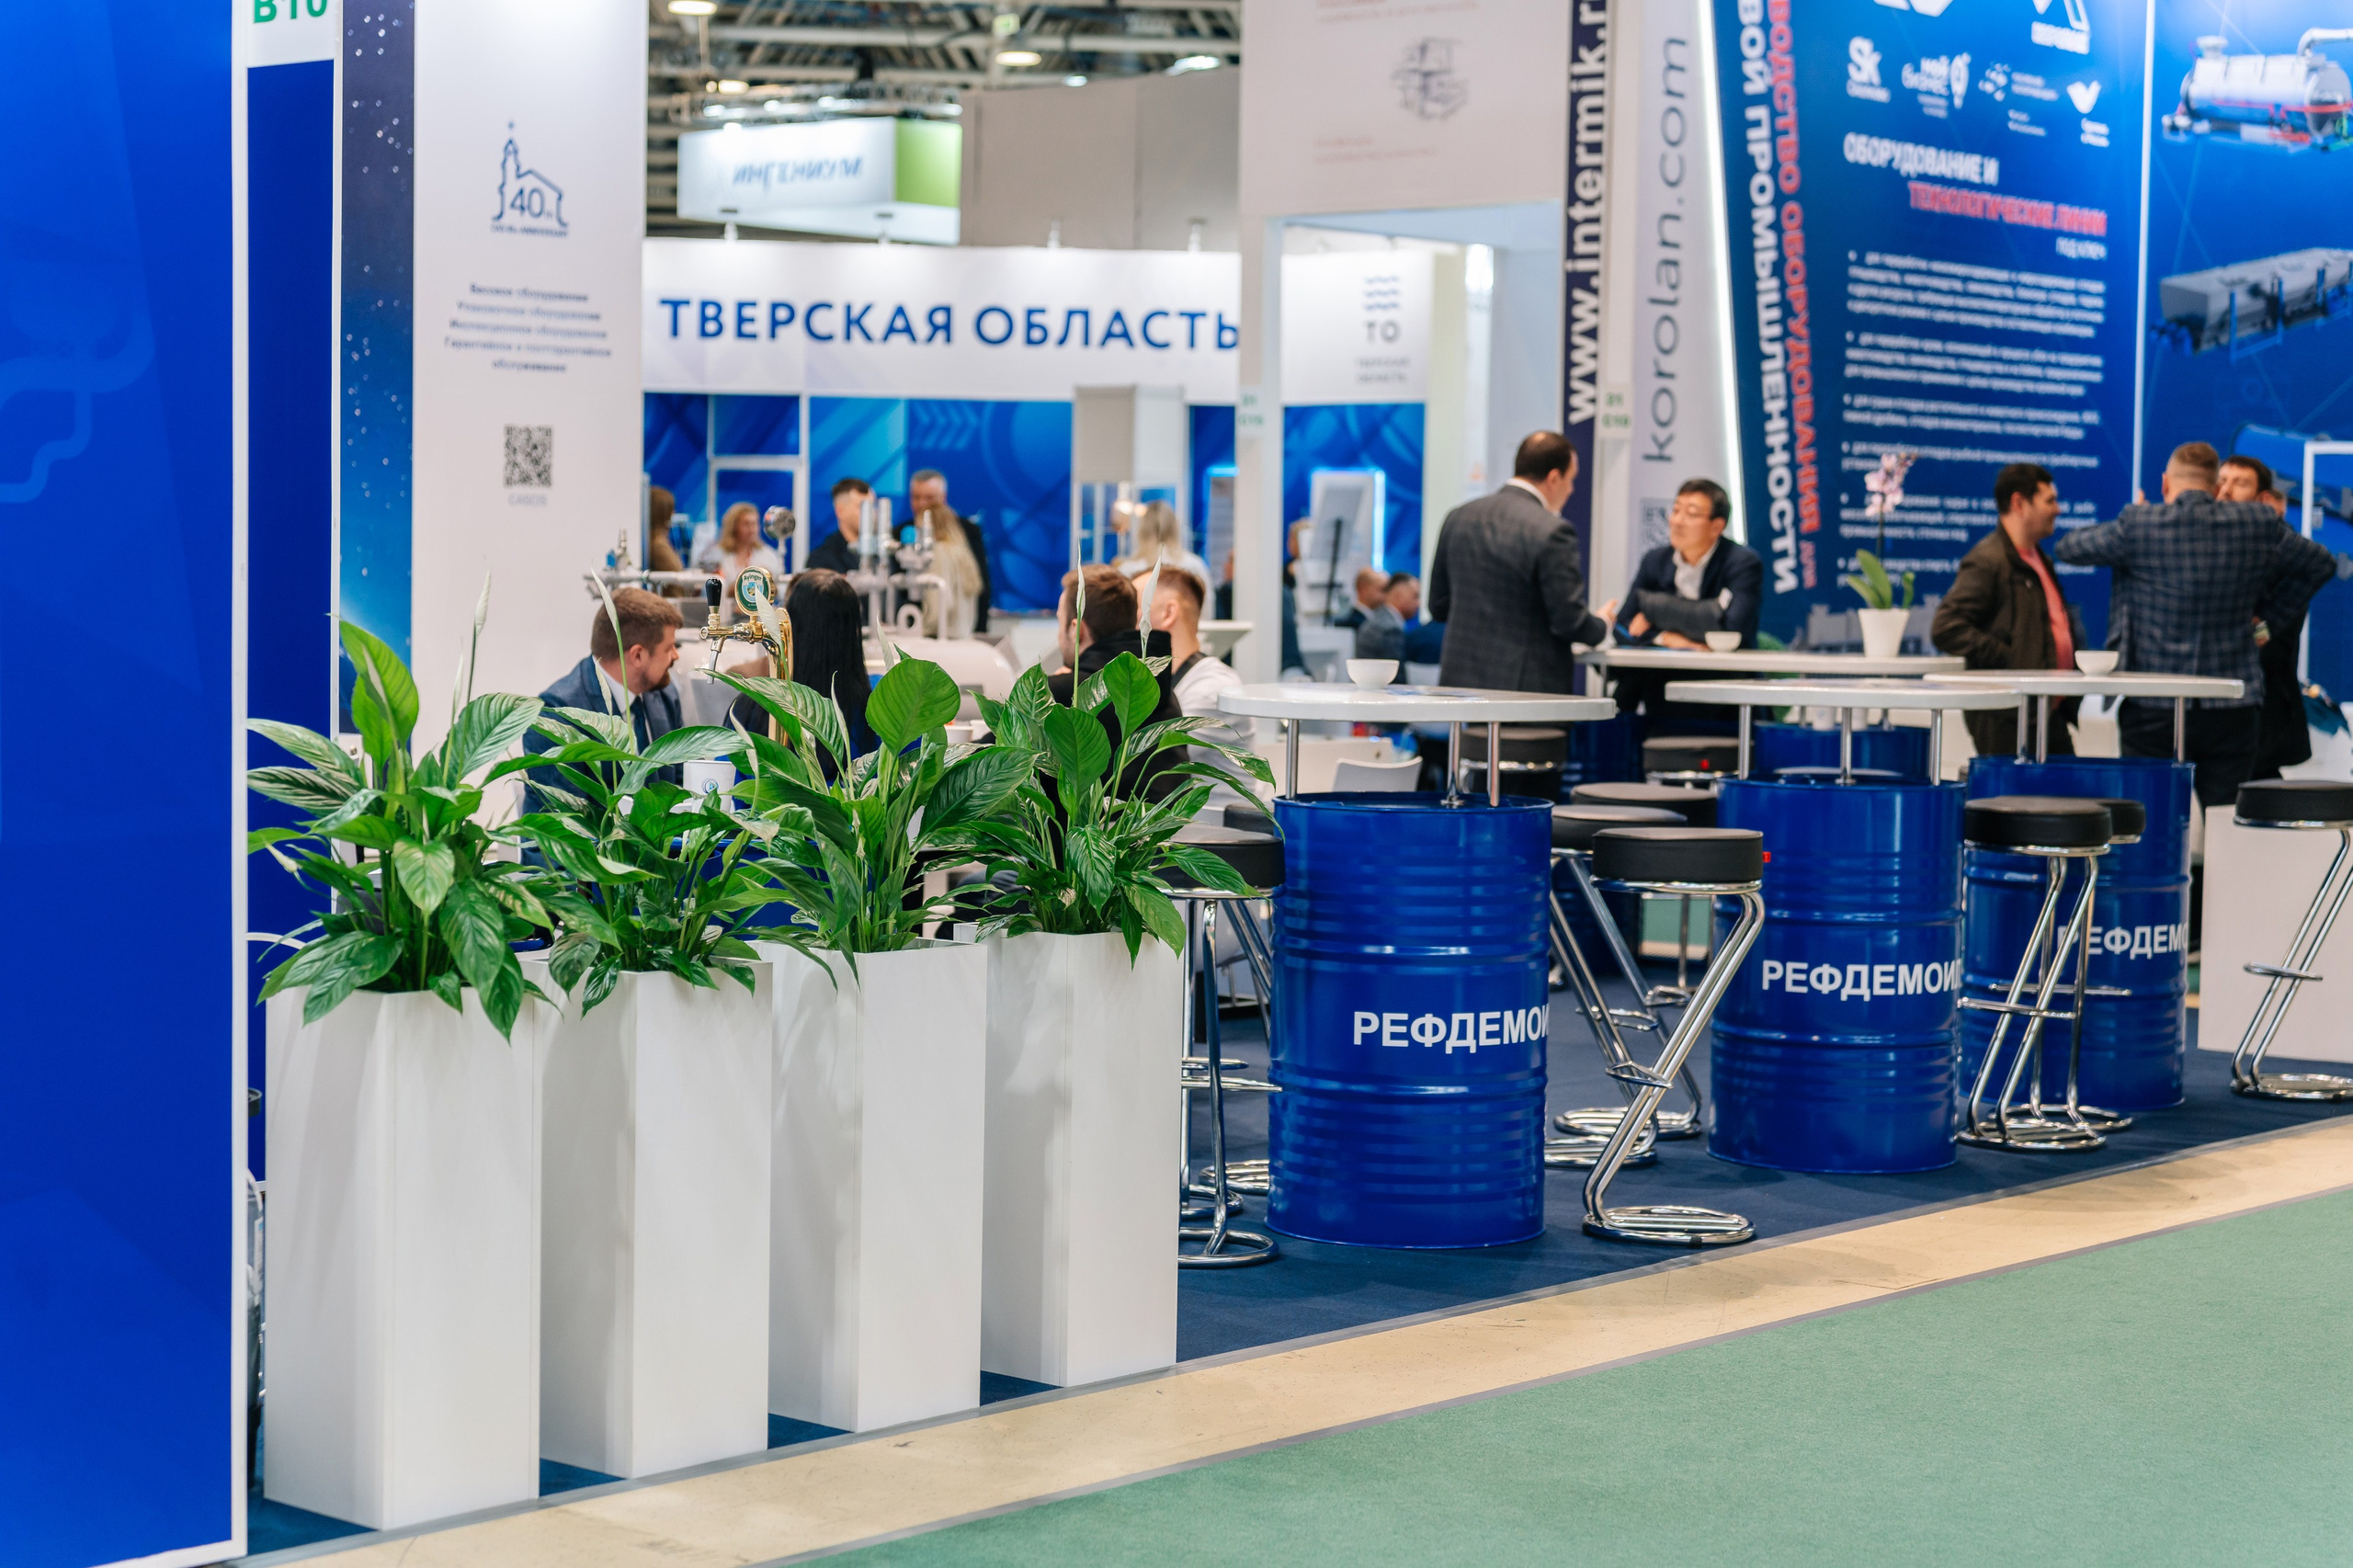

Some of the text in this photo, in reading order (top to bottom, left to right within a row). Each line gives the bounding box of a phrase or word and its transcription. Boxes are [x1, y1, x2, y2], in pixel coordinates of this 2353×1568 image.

[1643, 37, 1688, 462] korolan.com
[1843, 131, 1983, 185] ОБОРУДОВАНИЕ
[660, 299, 1238, 349] ТВЕРСКАЯ ОБЛАСТЬ
[1745, 104, 1799, 594] ПРОМЫШЛЕННОСТИ
